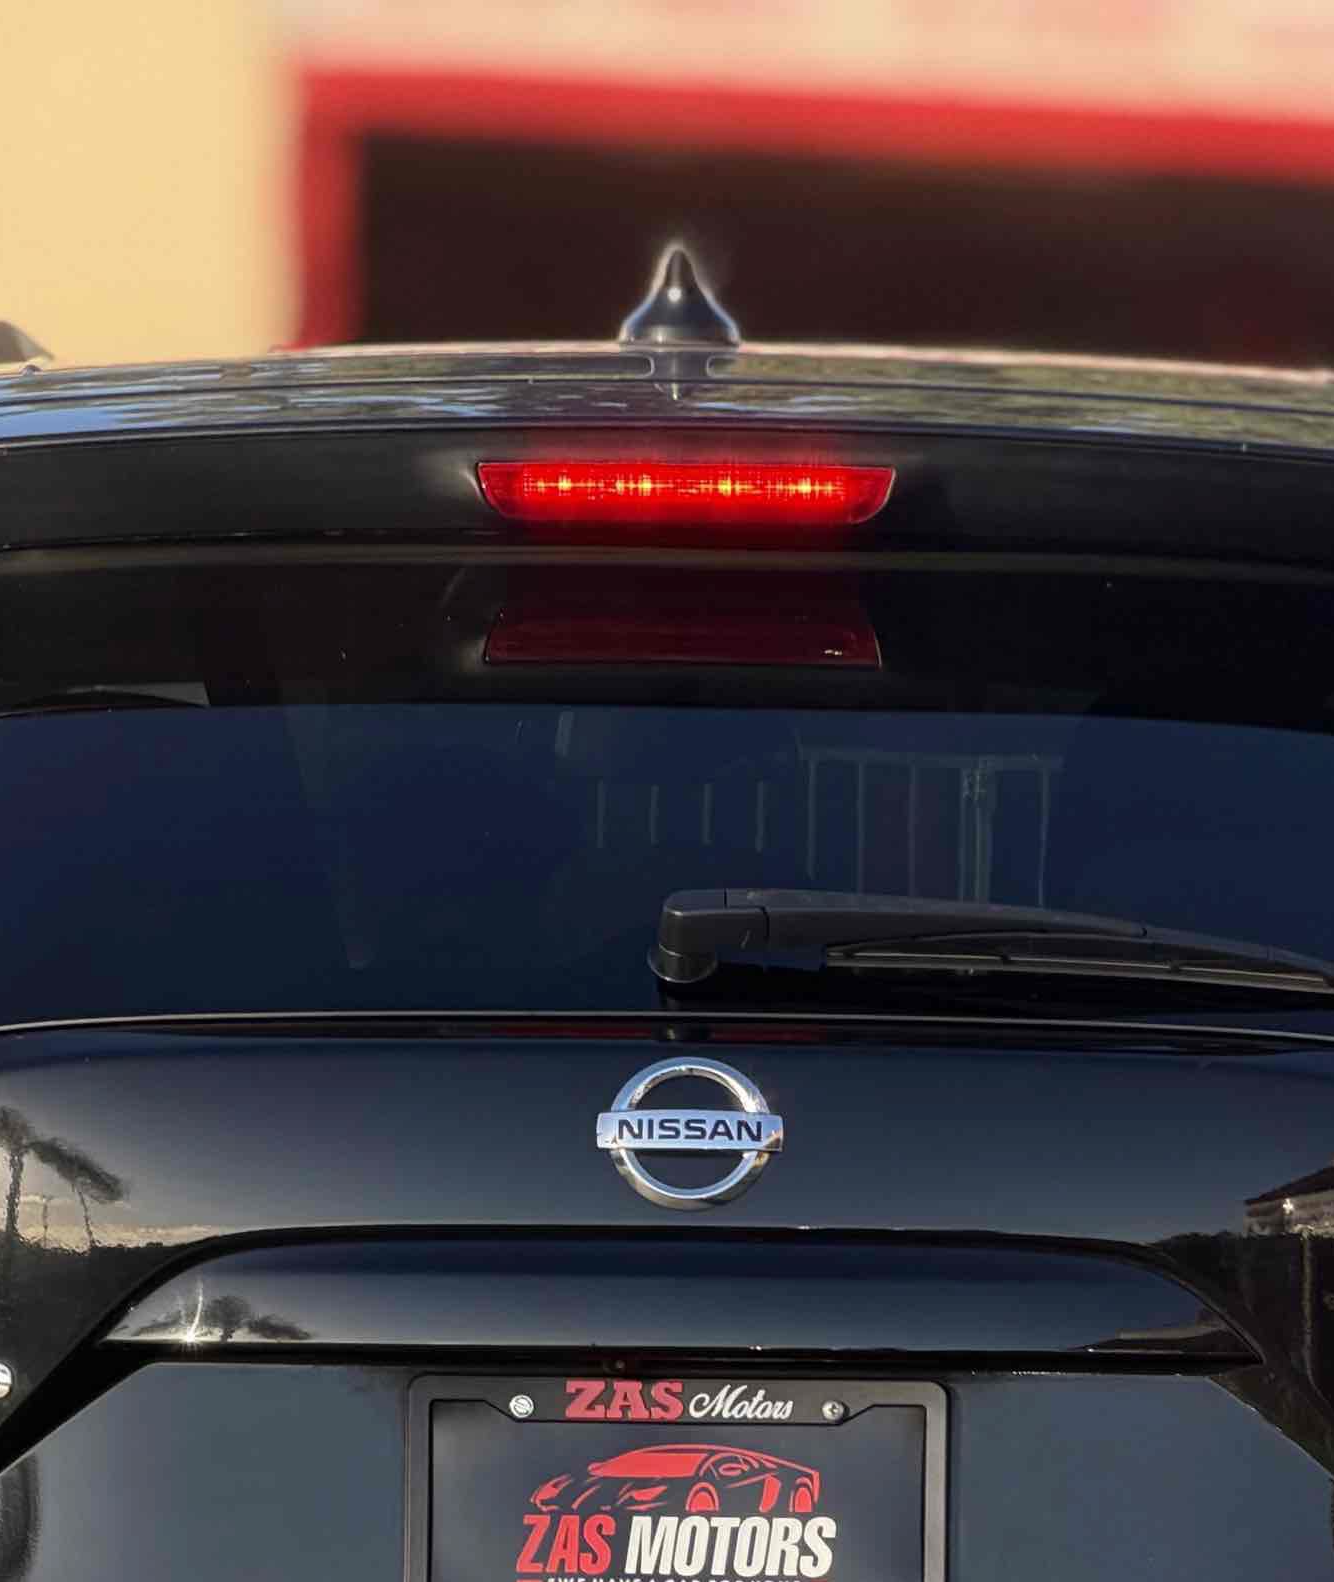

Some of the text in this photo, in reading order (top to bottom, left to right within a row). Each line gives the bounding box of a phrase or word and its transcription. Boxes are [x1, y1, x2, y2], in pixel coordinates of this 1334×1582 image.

[618, 1118, 763, 1142] NISSAN
[565, 1379, 794, 1421] ZAS Motors
[516, 1514, 837, 1578] ZAS MOTORS
